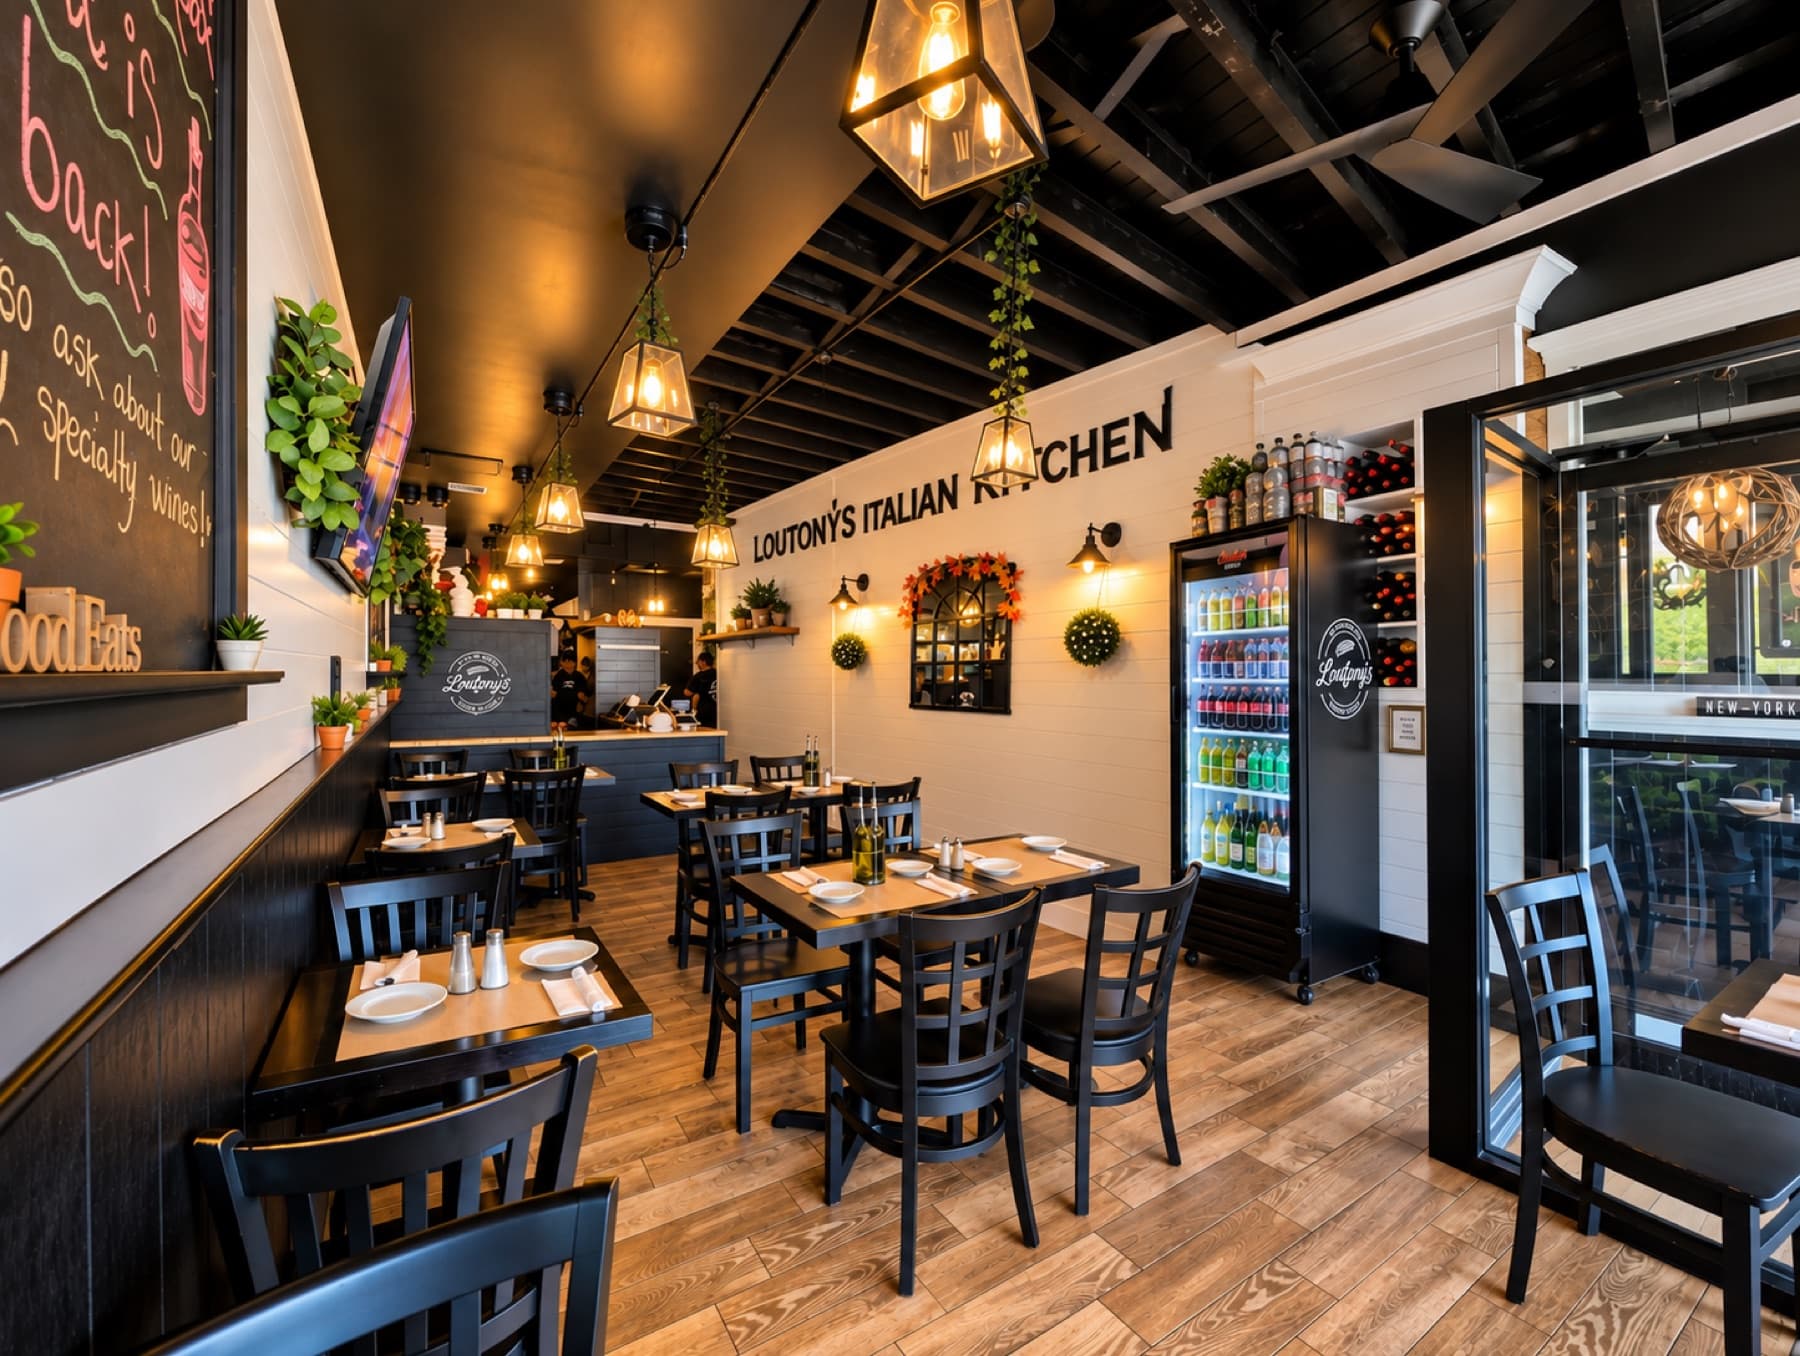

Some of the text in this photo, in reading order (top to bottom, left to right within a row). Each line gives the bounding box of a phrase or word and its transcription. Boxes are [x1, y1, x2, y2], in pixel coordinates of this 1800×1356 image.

[123, 12, 163, 170] is
[21, 14, 157, 338] back!
[53, 324, 104, 401] ask
[113, 374, 165, 451] about
[171, 433, 197, 472] our
[863, 473, 959, 534] ITALIAN
[973, 385, 1174, 505] CHEN
[442, 674, 512, 696] Loutony's
[1706, 700, 1797, 717] NEW-YORK
